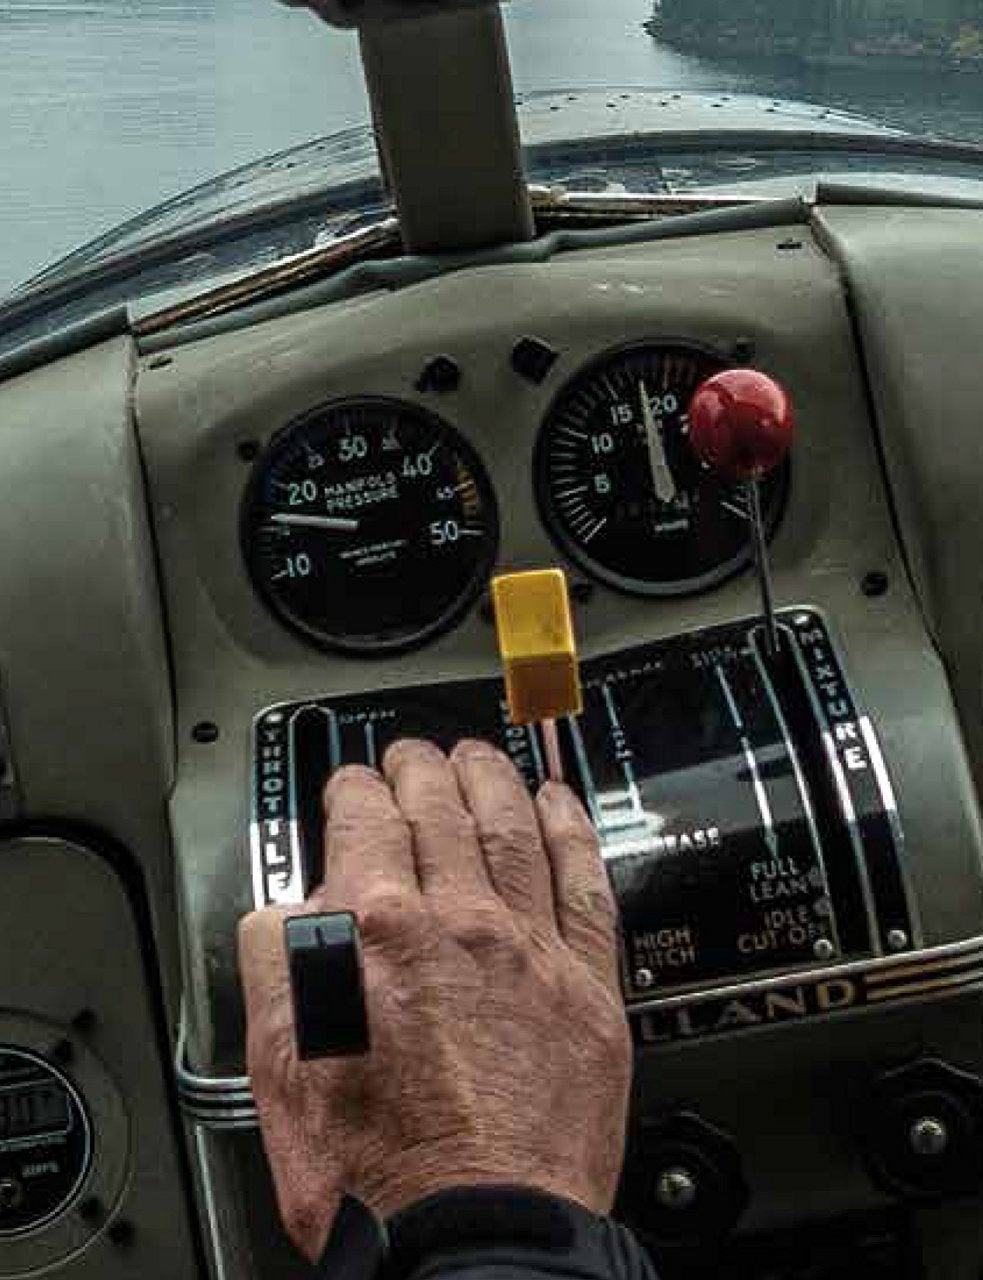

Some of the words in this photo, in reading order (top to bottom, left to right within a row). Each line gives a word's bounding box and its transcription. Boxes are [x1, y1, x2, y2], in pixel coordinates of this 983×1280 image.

[610, 404, 633, 426] 15
[591, 433, 614, 455] 10
[403, 453, 432, 478] 40
[288, 479, 317, 506] 20
[593, 473, 611, 495] 5
[429, 520, 459, 546] 50
[286, 553, 311, 578] 10
[750, 856, 801, 881] FULL
[750, 875, 809, 903] LEAN
[764, 904, 809, 931] IDLE
[738, 929, 778, 954] CUT
